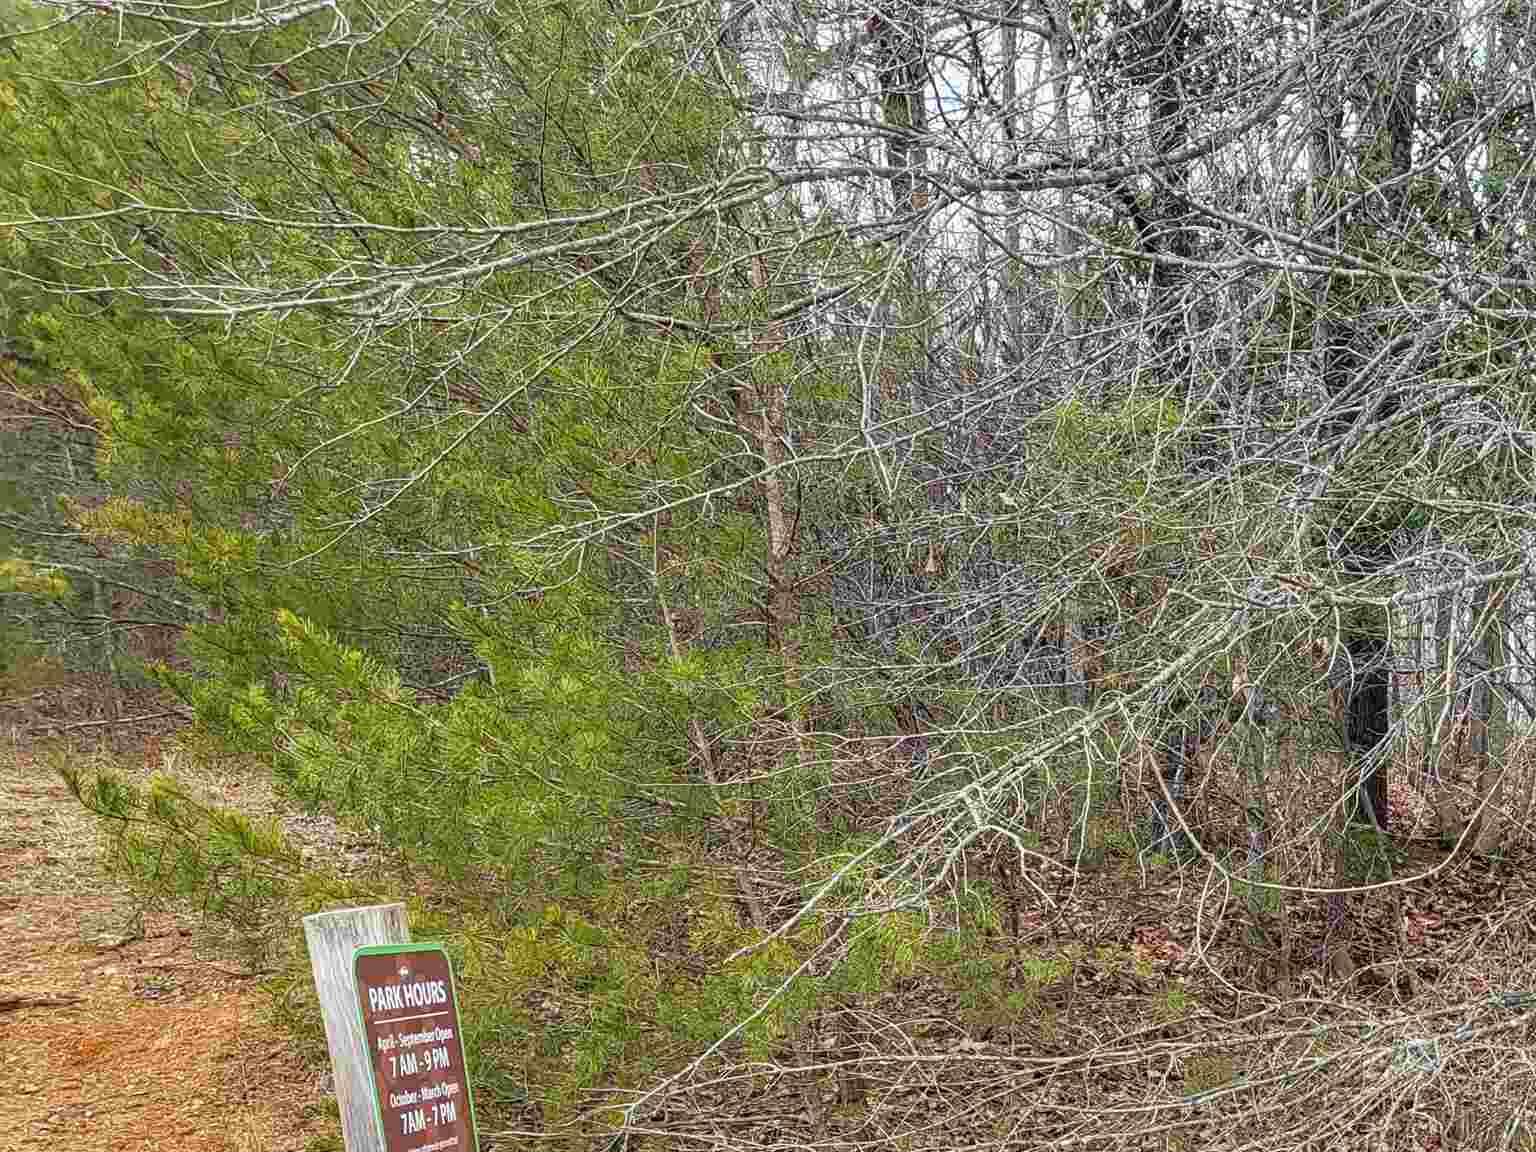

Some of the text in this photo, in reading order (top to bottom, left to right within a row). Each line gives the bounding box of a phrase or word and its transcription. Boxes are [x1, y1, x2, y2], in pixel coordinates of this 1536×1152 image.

[368, 980, 447, 1012] PARK HOURS
[434, 1026, 453, 1043] Open
[389, 1056, 397, 1078] 7
[400, 1053, 417, 1077] AM
[424, 1049, 432, 1071] 9
[432, 1046, 450, 1069] PM
[432, 1105, 438, 1126] 7
[440, 1101, 456, 1124] PM
